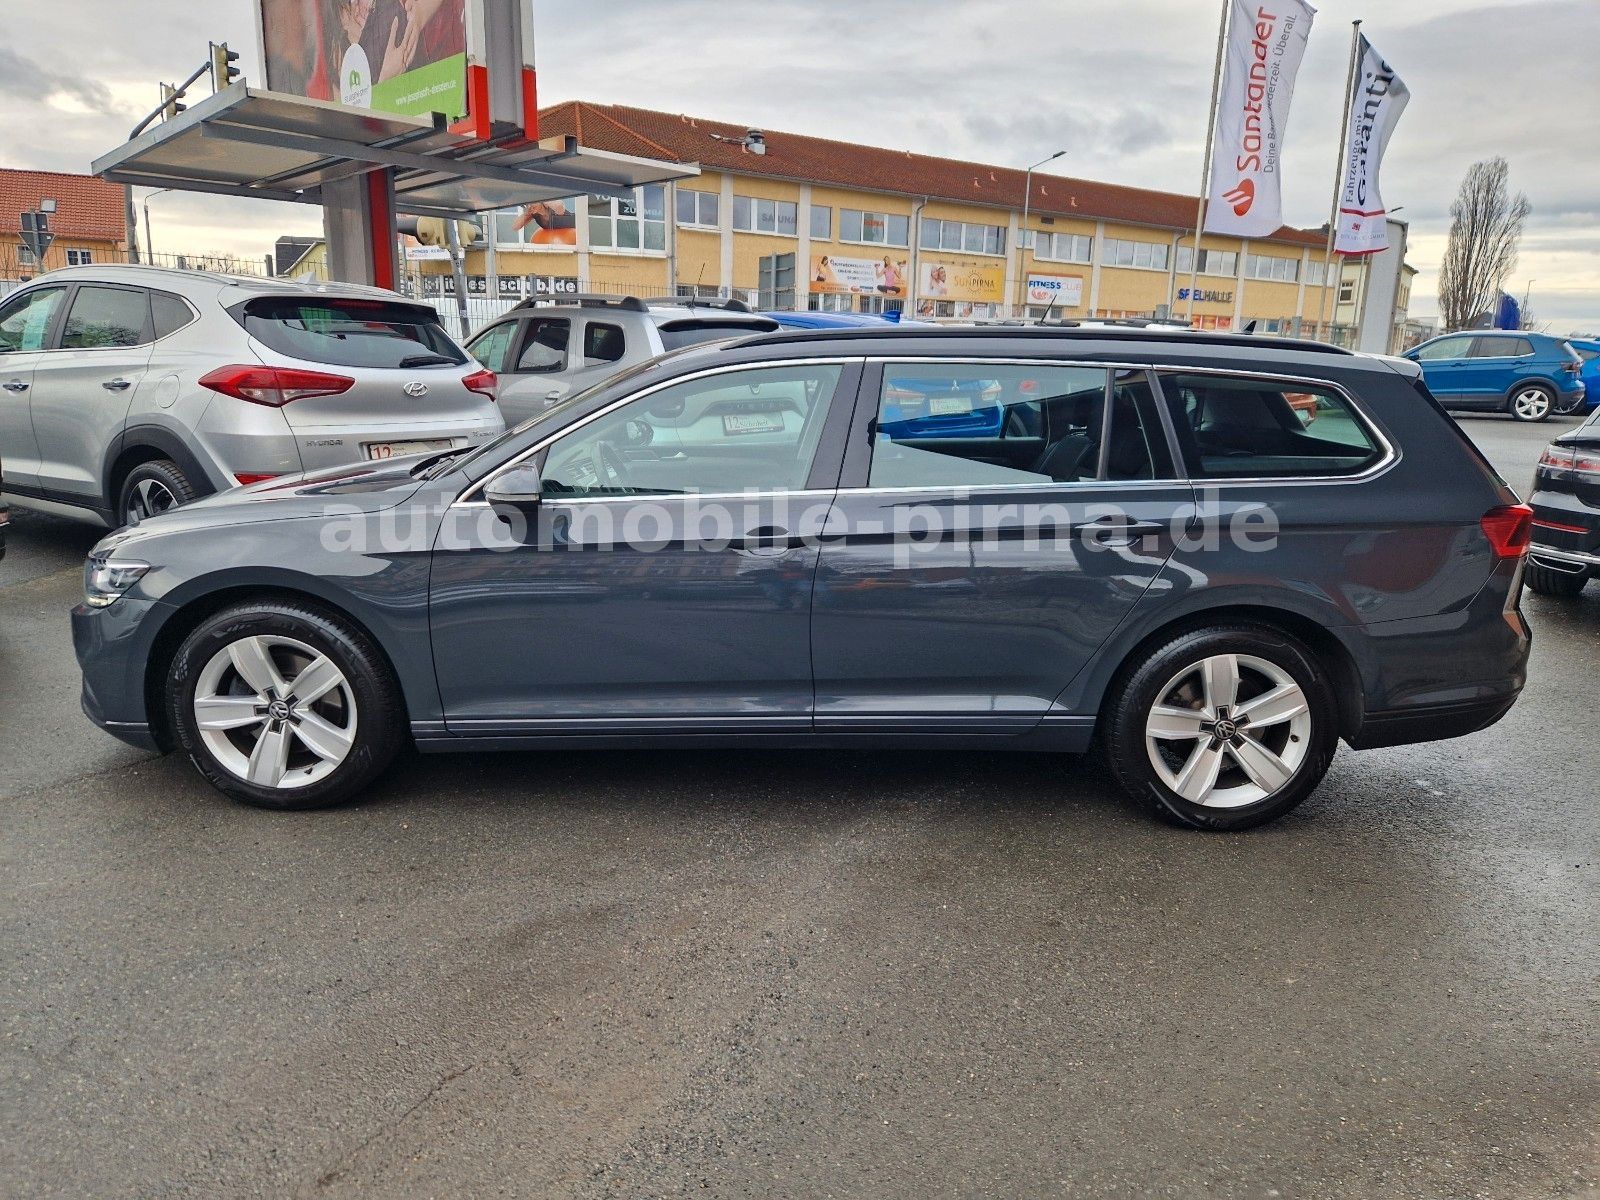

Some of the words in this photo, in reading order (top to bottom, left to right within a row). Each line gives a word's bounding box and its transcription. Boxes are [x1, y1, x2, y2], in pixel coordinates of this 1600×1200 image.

[1236, 6, 1277, 172] Santander
[1266, 60, 1281, 114] ederzeit.
[1263, 143, 1276, 173] Deine
[1345, 138, 1362, 203] Fahrzeuge
[1028, 280, 1061, 290] FITNESS
[1062, 282, 1082, 291] CLUB
[306, 439, 343, 447] HYUNDAI
[373, 446, 391, 460] 12
